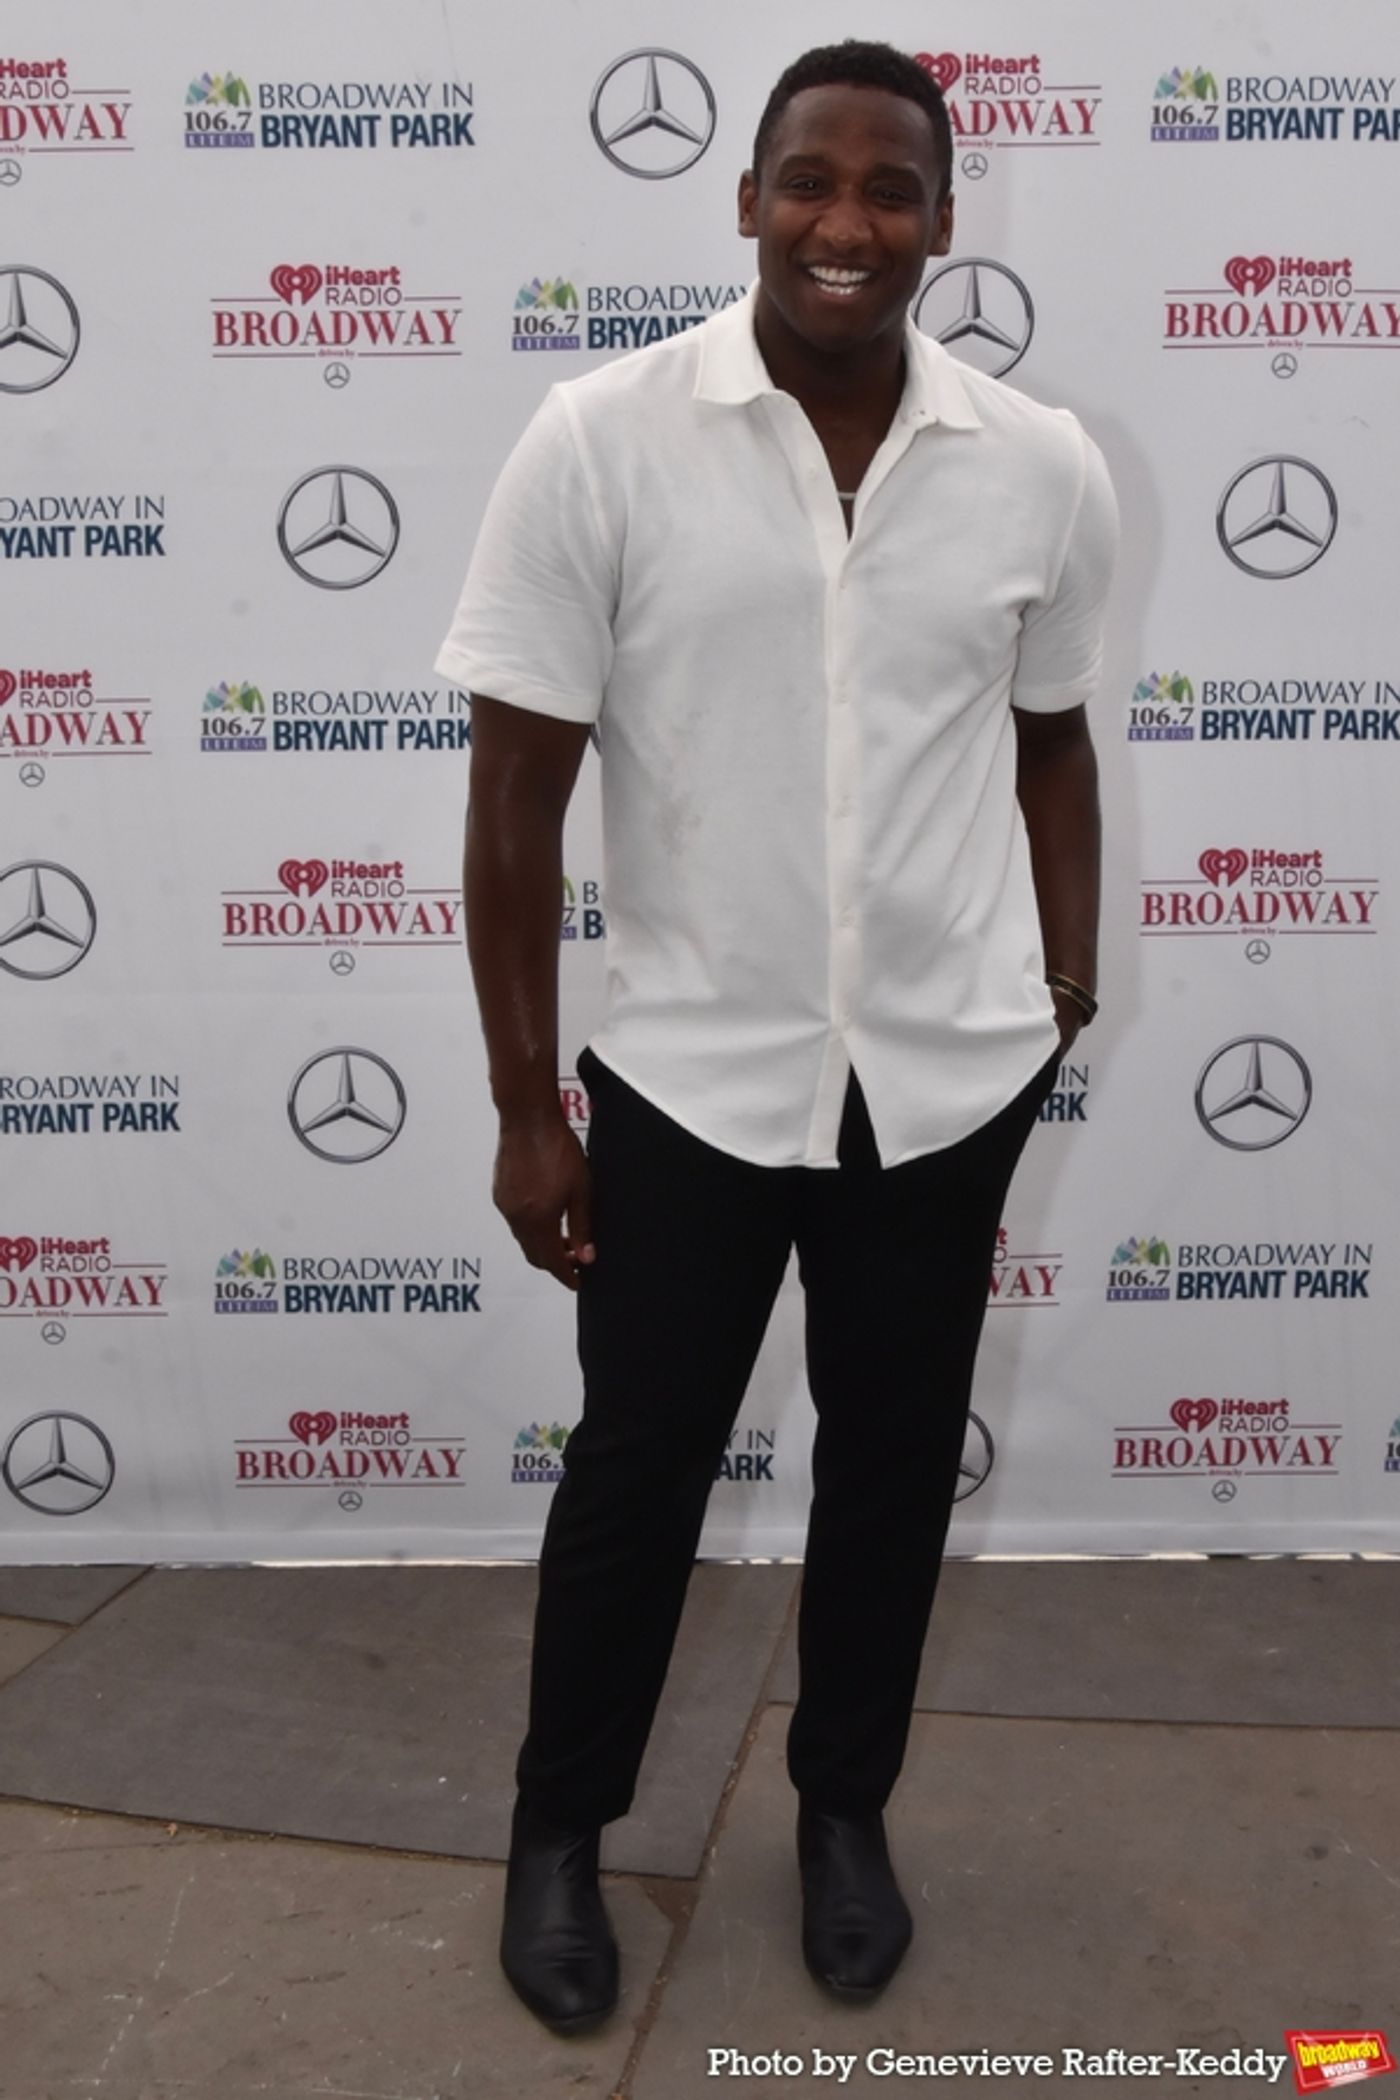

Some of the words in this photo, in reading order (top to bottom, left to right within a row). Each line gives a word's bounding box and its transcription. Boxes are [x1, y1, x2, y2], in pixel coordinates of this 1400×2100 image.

[965, 53, 1040, 74] iHeart
[258, 82, 431, 109] BROADWAY
[443, 82, 473, 108] IN
[964, 76, 1042, 95] RADIO
[1227, 77, 1396, 103] BROADWAY
[0, 102, 132, 141] DWAY
[184, 111, 252, 131] 106.7
[1151, 105, 1219, 125] 106.7
[1227, 107, 1344, 141] BRYANT
[261, 115, 381, 147] BRYANT
[392, 113, 475, 148] PARK
[326, 265, 401, 286] iHeart
[1279, 256, 1352, 277] iHeart
[325, 287, 402, 306] RADIO
[588, 285, 747, 312] BROADWA
[1278, 278, 1352, 297] RADIO
[213, 309, 463, 347] BROADWAY
[513, 315, 579, 335] 106.7
[1164, 301, 1400, 338] BROADWAY
[0, 497, 125, 522] OADWAY
[135, 495, 165, 519] IN
[0, 525, 76, 559] YANT
[85, 524, 166, 557] PARK
[20, 669, 92, 689] iHeart
[20, 689, 94, 708] RADIO
[273, 691, 438, 715] BROADWAY
[449, 691, 471, 713] IN
[1202, 680, 1366, 705] BROADWAY
[1375, 681, 1400, 703] IN
[200, 718, 266, 736] 106.7
[1129, 707, 1194, 726] 106.7
[1201, 709, 1315, 741] BRYANT
[1324, 710, 1400, 741] PARK
[0, 711, 152, 747] ADWAY
[274, 720, 388, 751] BRYANT
[398, 719, 472, 750] PARK
[332, 860, 403, 879] iHeart
[1252, 849, 1322, 868] iHeart
[331, 880, 405, 898] RADIO
[1251, 869, 1323, 887] RADIO
[222, 901, 463, 937] BROADWAY
[1141, 890, 1379, 926] BROADWAY
[1061, 1064, 1089, 1088] IN
[0, 1075, 141, 1100] ROADWAY
[151, 1075, 179, 1097] IN
[0, 1103, 94, 1134] RYANT
[103, 1102, 181, 1133] PARK
[41, 1236, 110, 1255] iHeart
[1178, 1244, 1336, 1268] BROADWAY
[1344, 1244, 1373, 1266] IN
[40, 1255, 112, 1273] RADIO
[283, 1257, 443, 1280] BROADWAY
[452, 1257, 481, 1279] IN
[1108, 1270, 1170, 1287] 106.7
[1176, 1270, 1287, 1300] BRYANT
[1294, 1269, 1370, 1299] PARK
[0, 1275, 168, 1308] OADWAY
[214, 1282, 277, 1299] 106.7
[284, 1284, 395, 1313] BRYANT
[404, 1283, 482, 1313] PARK
[1221, 1398, 1289, 1415] iHeart
[340, 1412, 410, 1429] iHeart
[1219, 1416, 1289, 1433] RADIO
[339, 1430, 411, 1446] RADIO
[747, 1429, 775, 1450] IN
[511, 1453, 563, 1469] 106.
[1114, 1436, 1342, 1468] BROADWAY
[236, 1448, 466, 1480] BROADWAY
